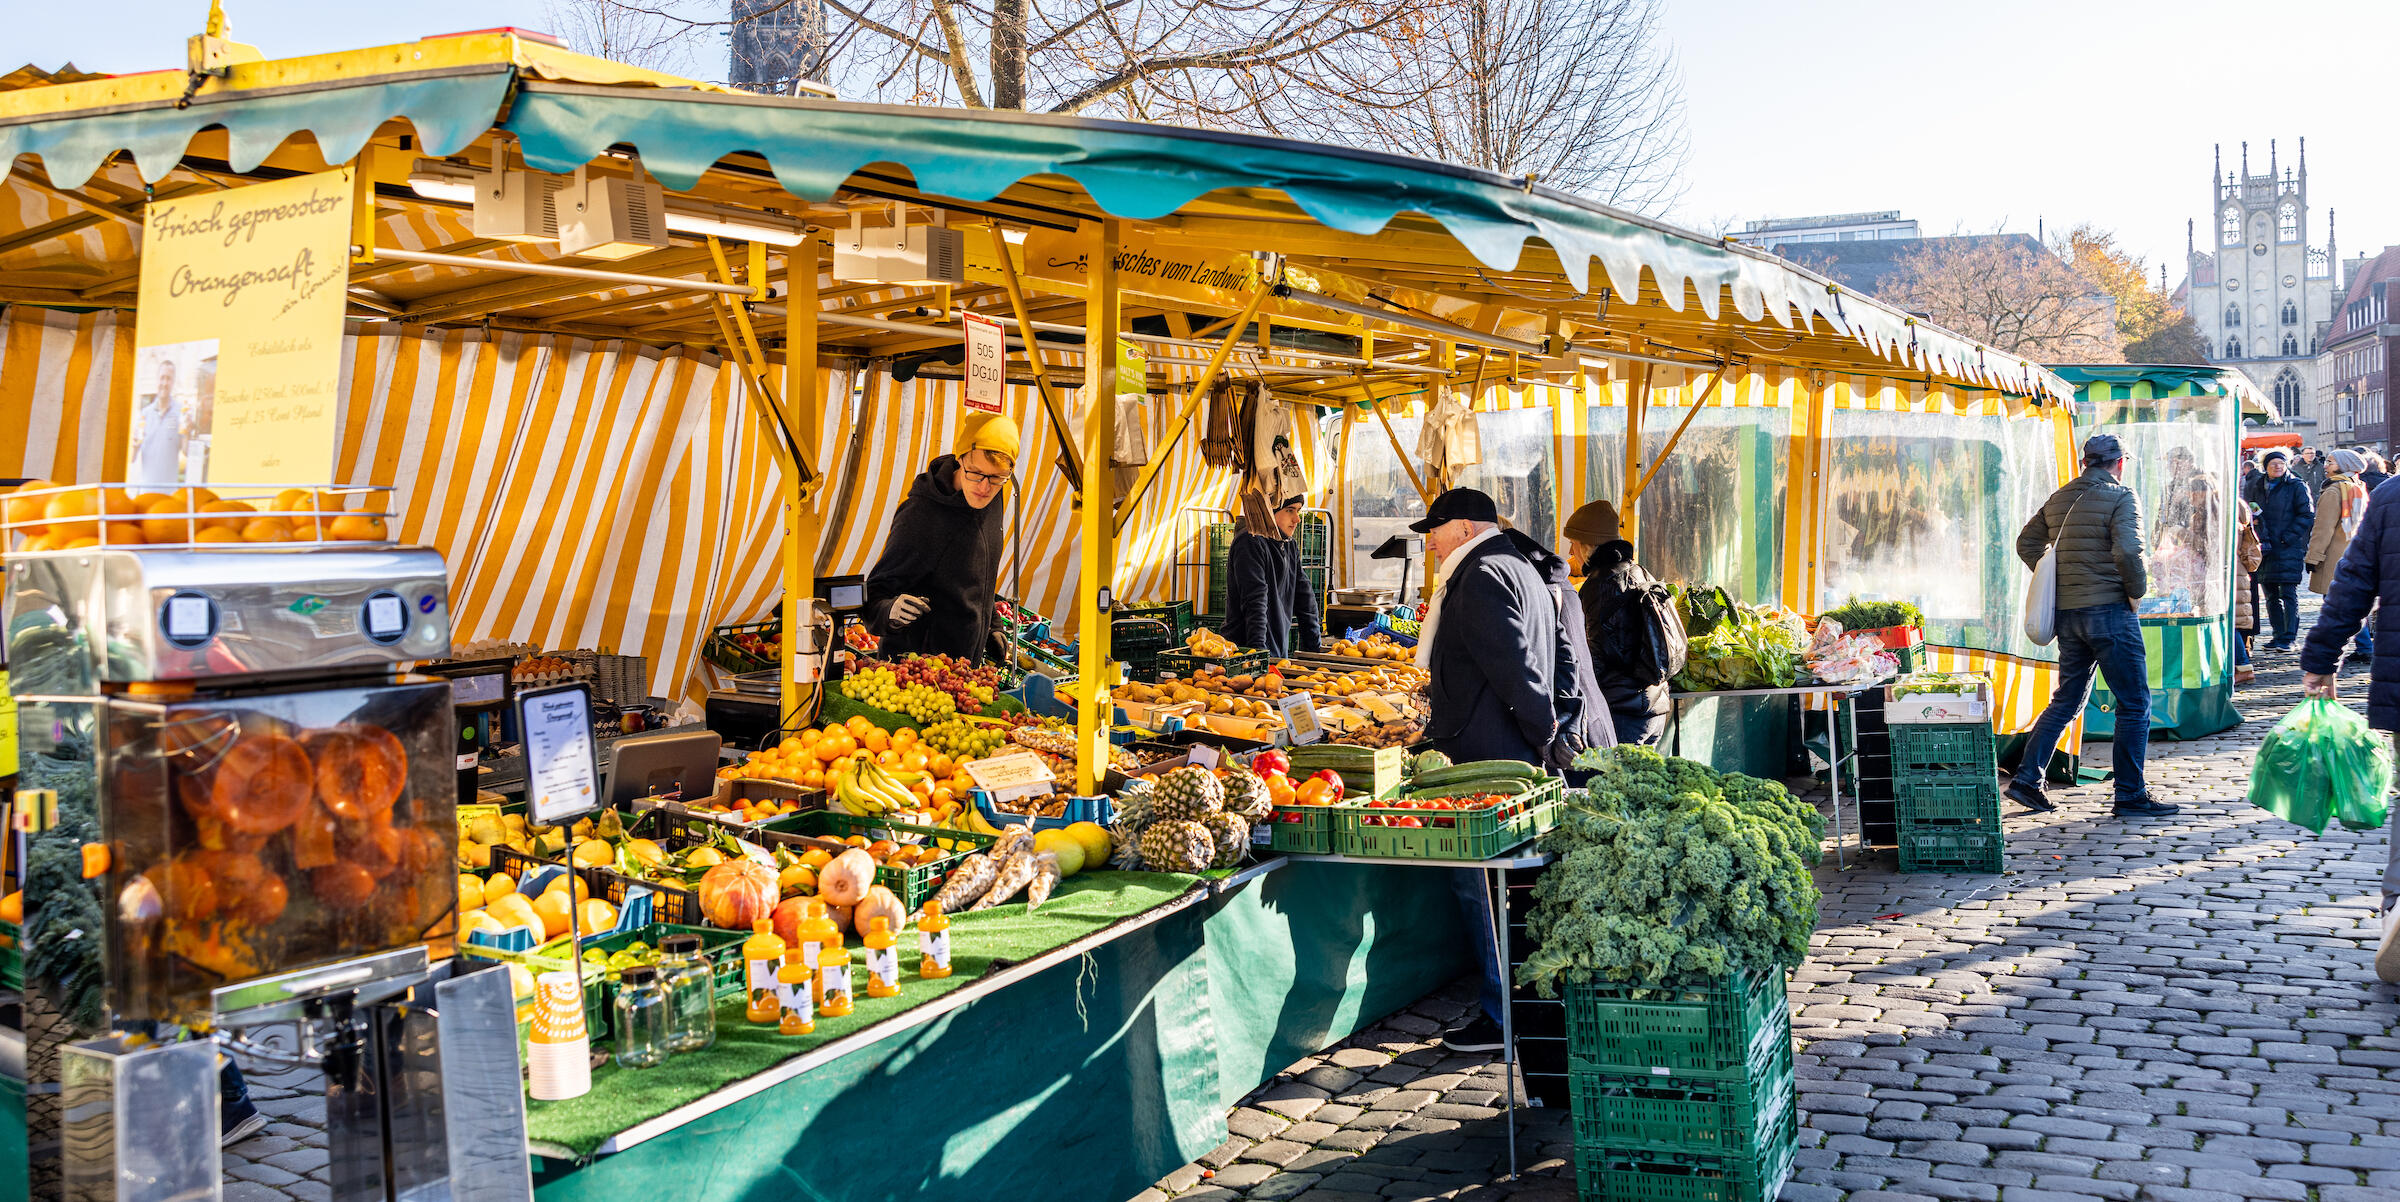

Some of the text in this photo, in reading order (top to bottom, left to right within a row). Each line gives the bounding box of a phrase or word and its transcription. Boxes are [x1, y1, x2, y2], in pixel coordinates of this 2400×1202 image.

[153, 187, 343, 247] Frisch gepresster
[170, 247, 315, 307] Orangensaft
[1115, 245, 1161, 276] isches
[1160, 261, 1192, 281] vom
[977, 342, 994, 359] 505
[972, 363, 999, 382] DG10
